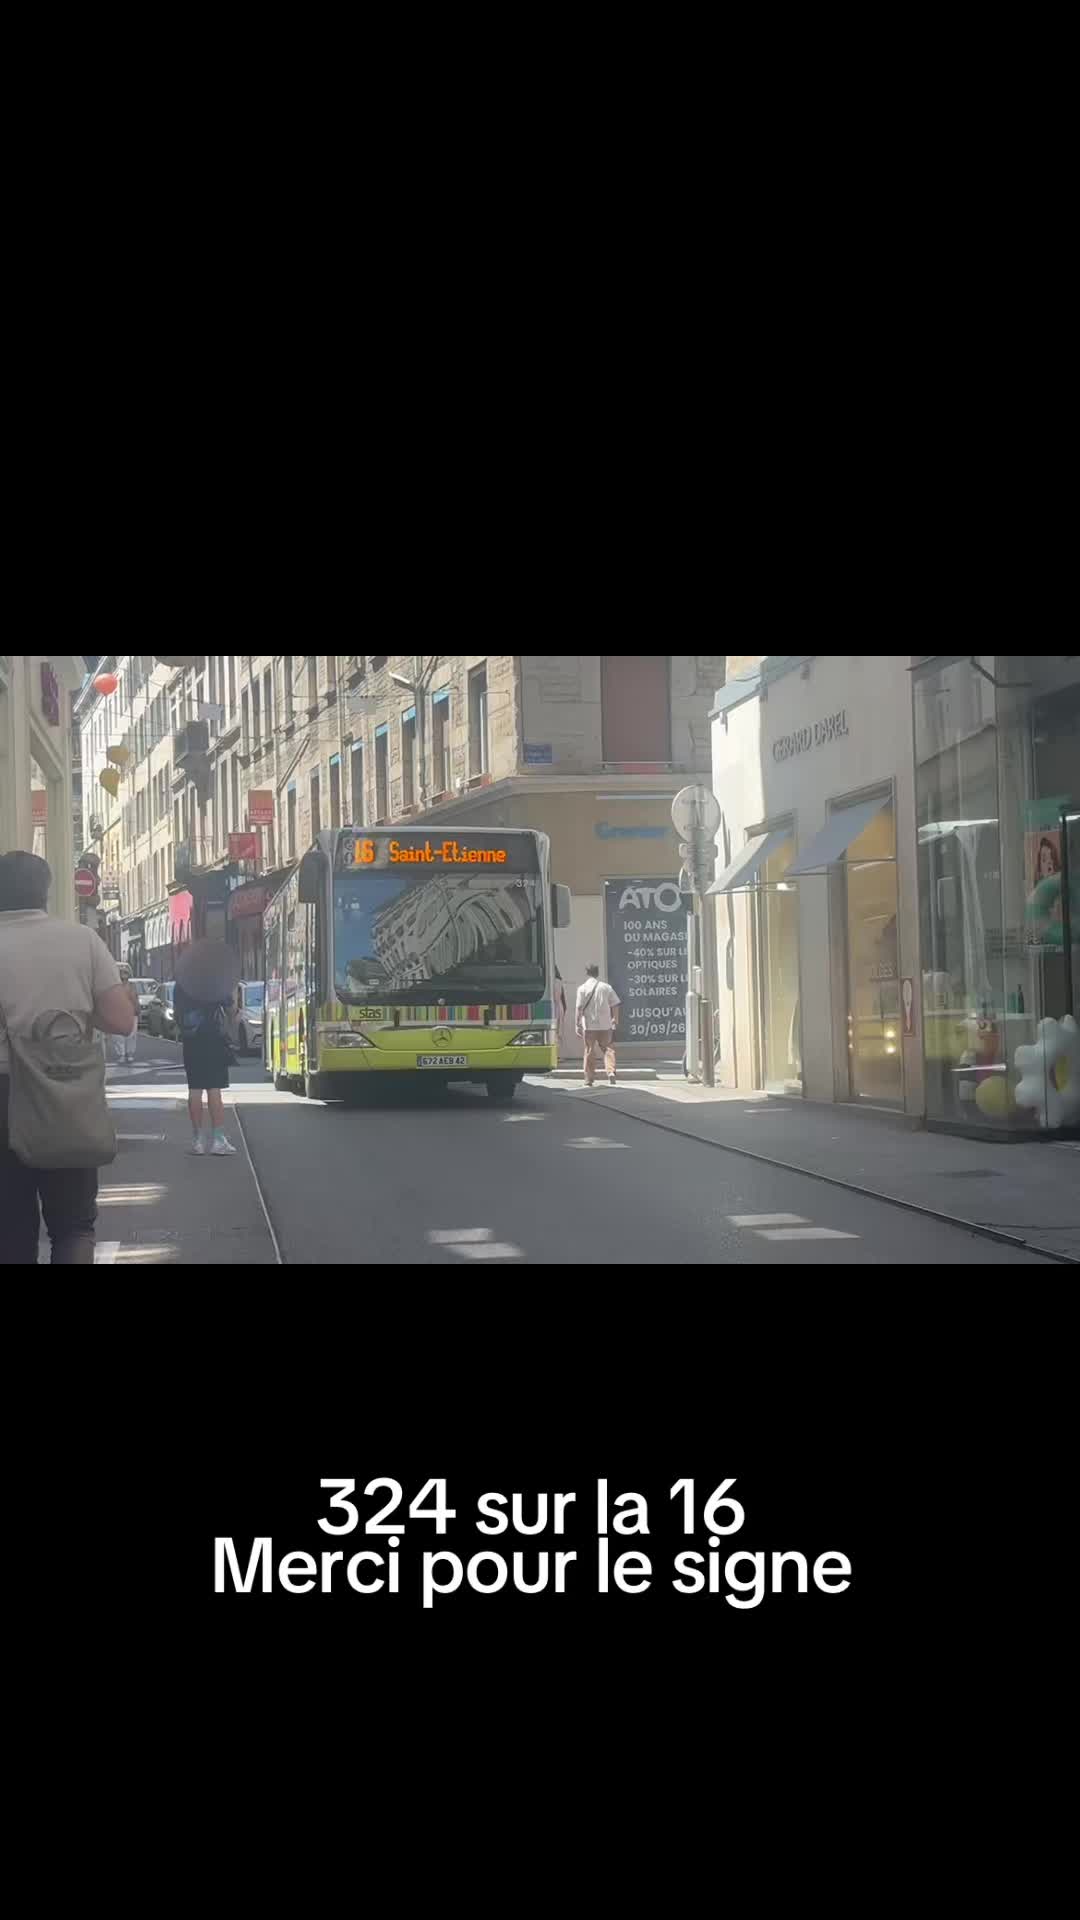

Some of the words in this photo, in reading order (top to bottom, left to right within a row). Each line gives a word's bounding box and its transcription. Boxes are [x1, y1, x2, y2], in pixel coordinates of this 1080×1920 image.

[354, 839, 375, 864] 16
[389, 840, 507, 864] Saint-Etienne
[619, 882, 682, 912] ATO
[624, 920, 641, 930] 100
[644, 920, 668, 930] ANS
[624, 932, 641, 943] DU
[627, 948, 654, 957] -40%
[656, 947, 677, 957] SUR
[627, 959, 678, 970] OPTIQUES
[628, 974, 656, 984] -30%
[657, 973, 679, 984] SUR
[628, 986, 678, 997] SOLAIRES
[359, 1007, 382, 1019] stas
[630, 1020, 686, 1037] 30/09/26
